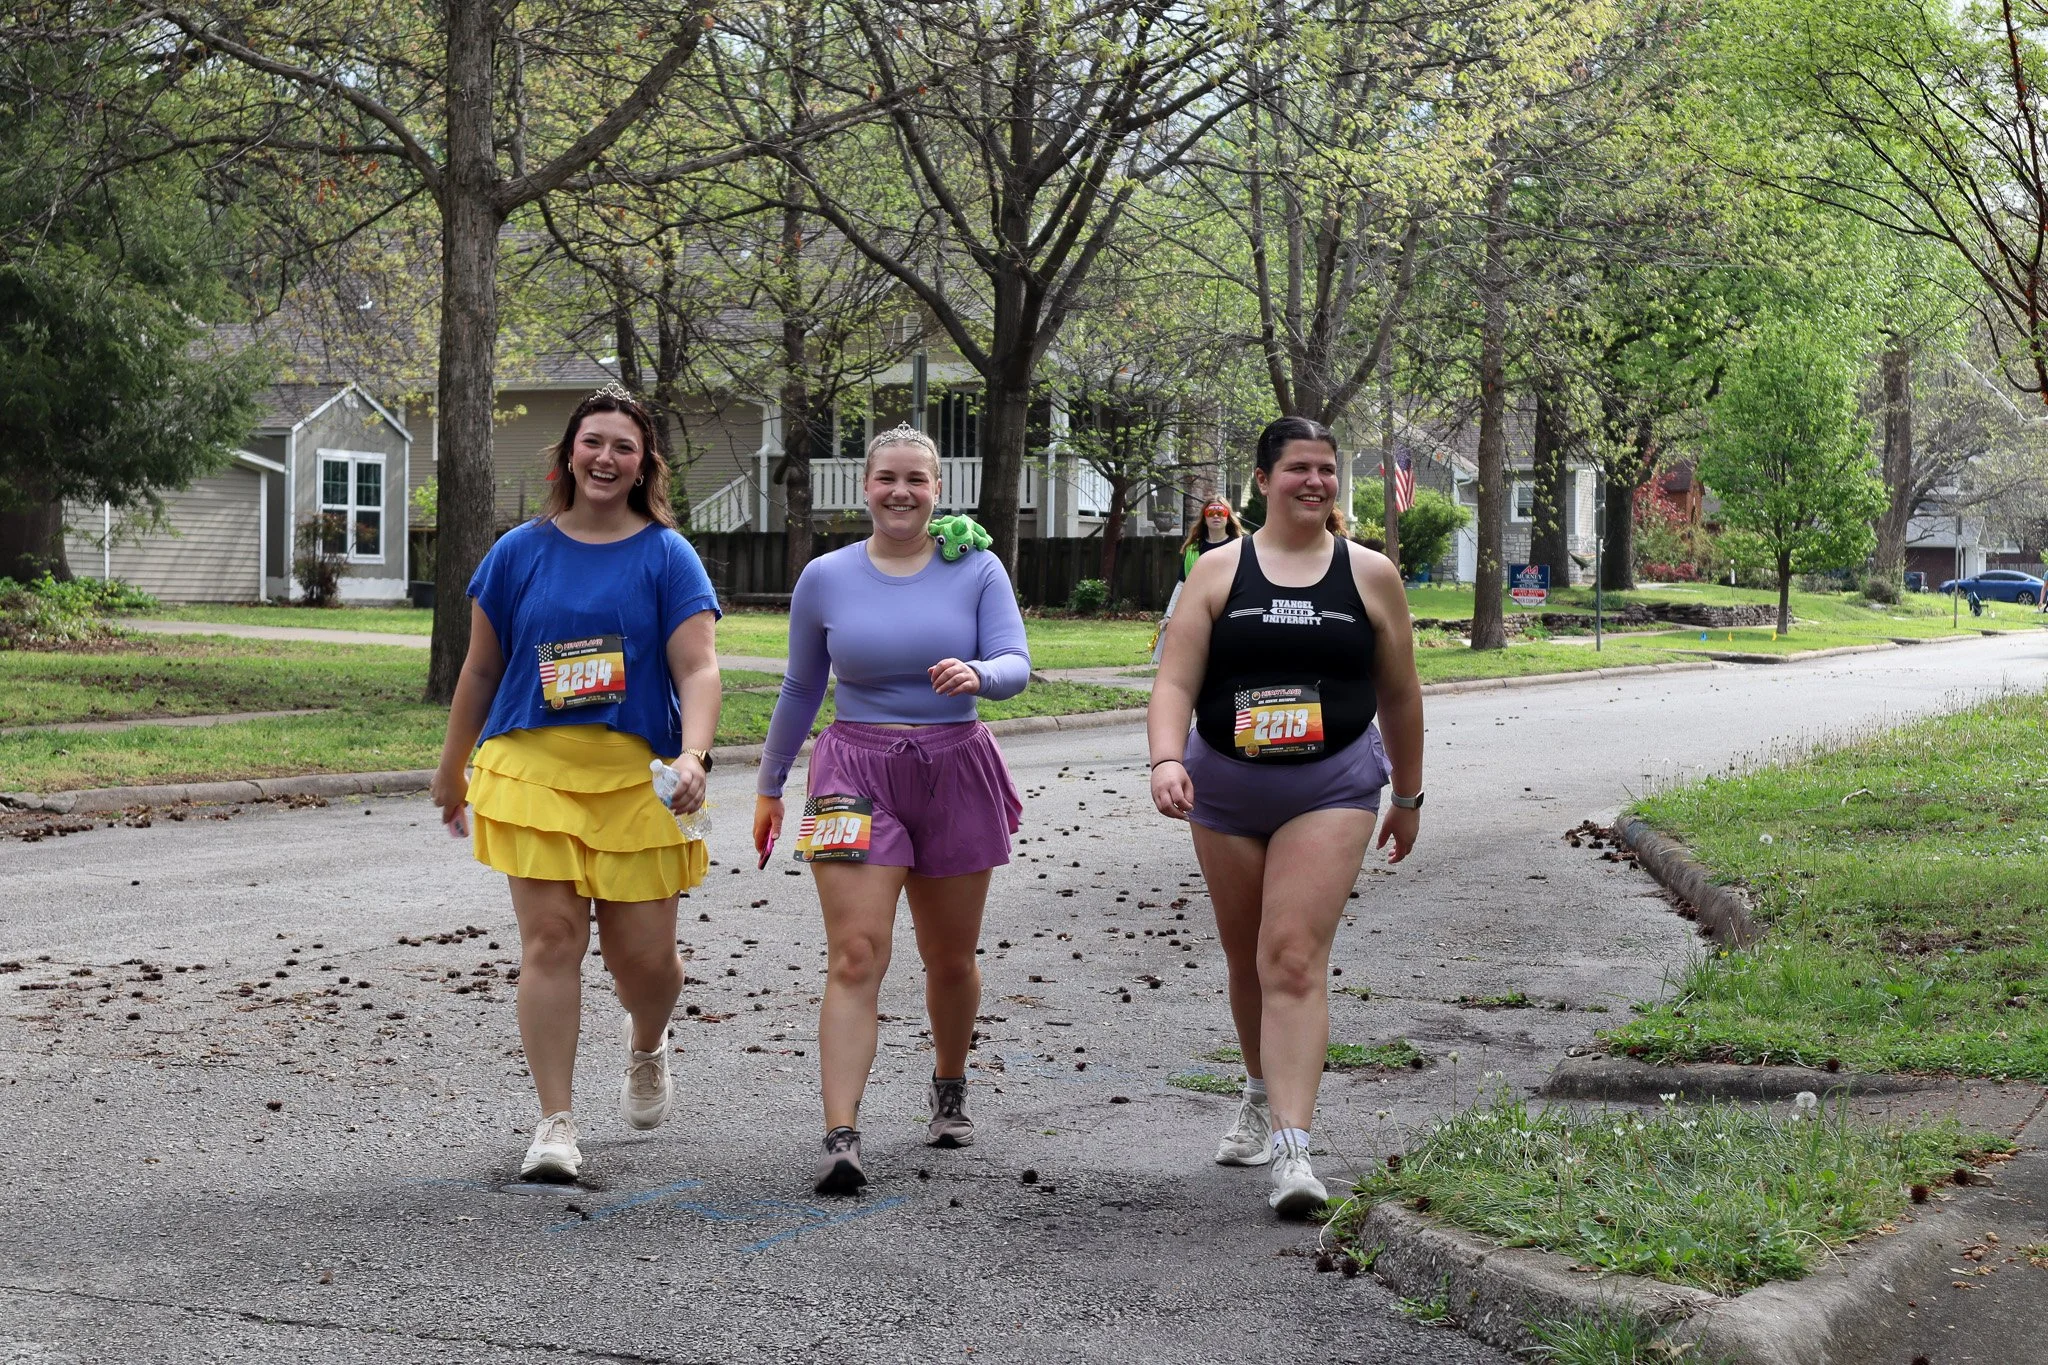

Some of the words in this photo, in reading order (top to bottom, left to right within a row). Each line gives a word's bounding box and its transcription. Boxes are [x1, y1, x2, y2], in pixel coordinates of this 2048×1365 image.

[1272, 599, 1314, 609] EVANGEL
[1276, 608, 1309, 616] CHEER
[1262, 614, 1322, 625] UNIVERSITY
[556, 659, 613, 693] 2294
[1260, 688, 1302, 697] HEARTLAND
[1254, 708, 1309, 740] 2213
